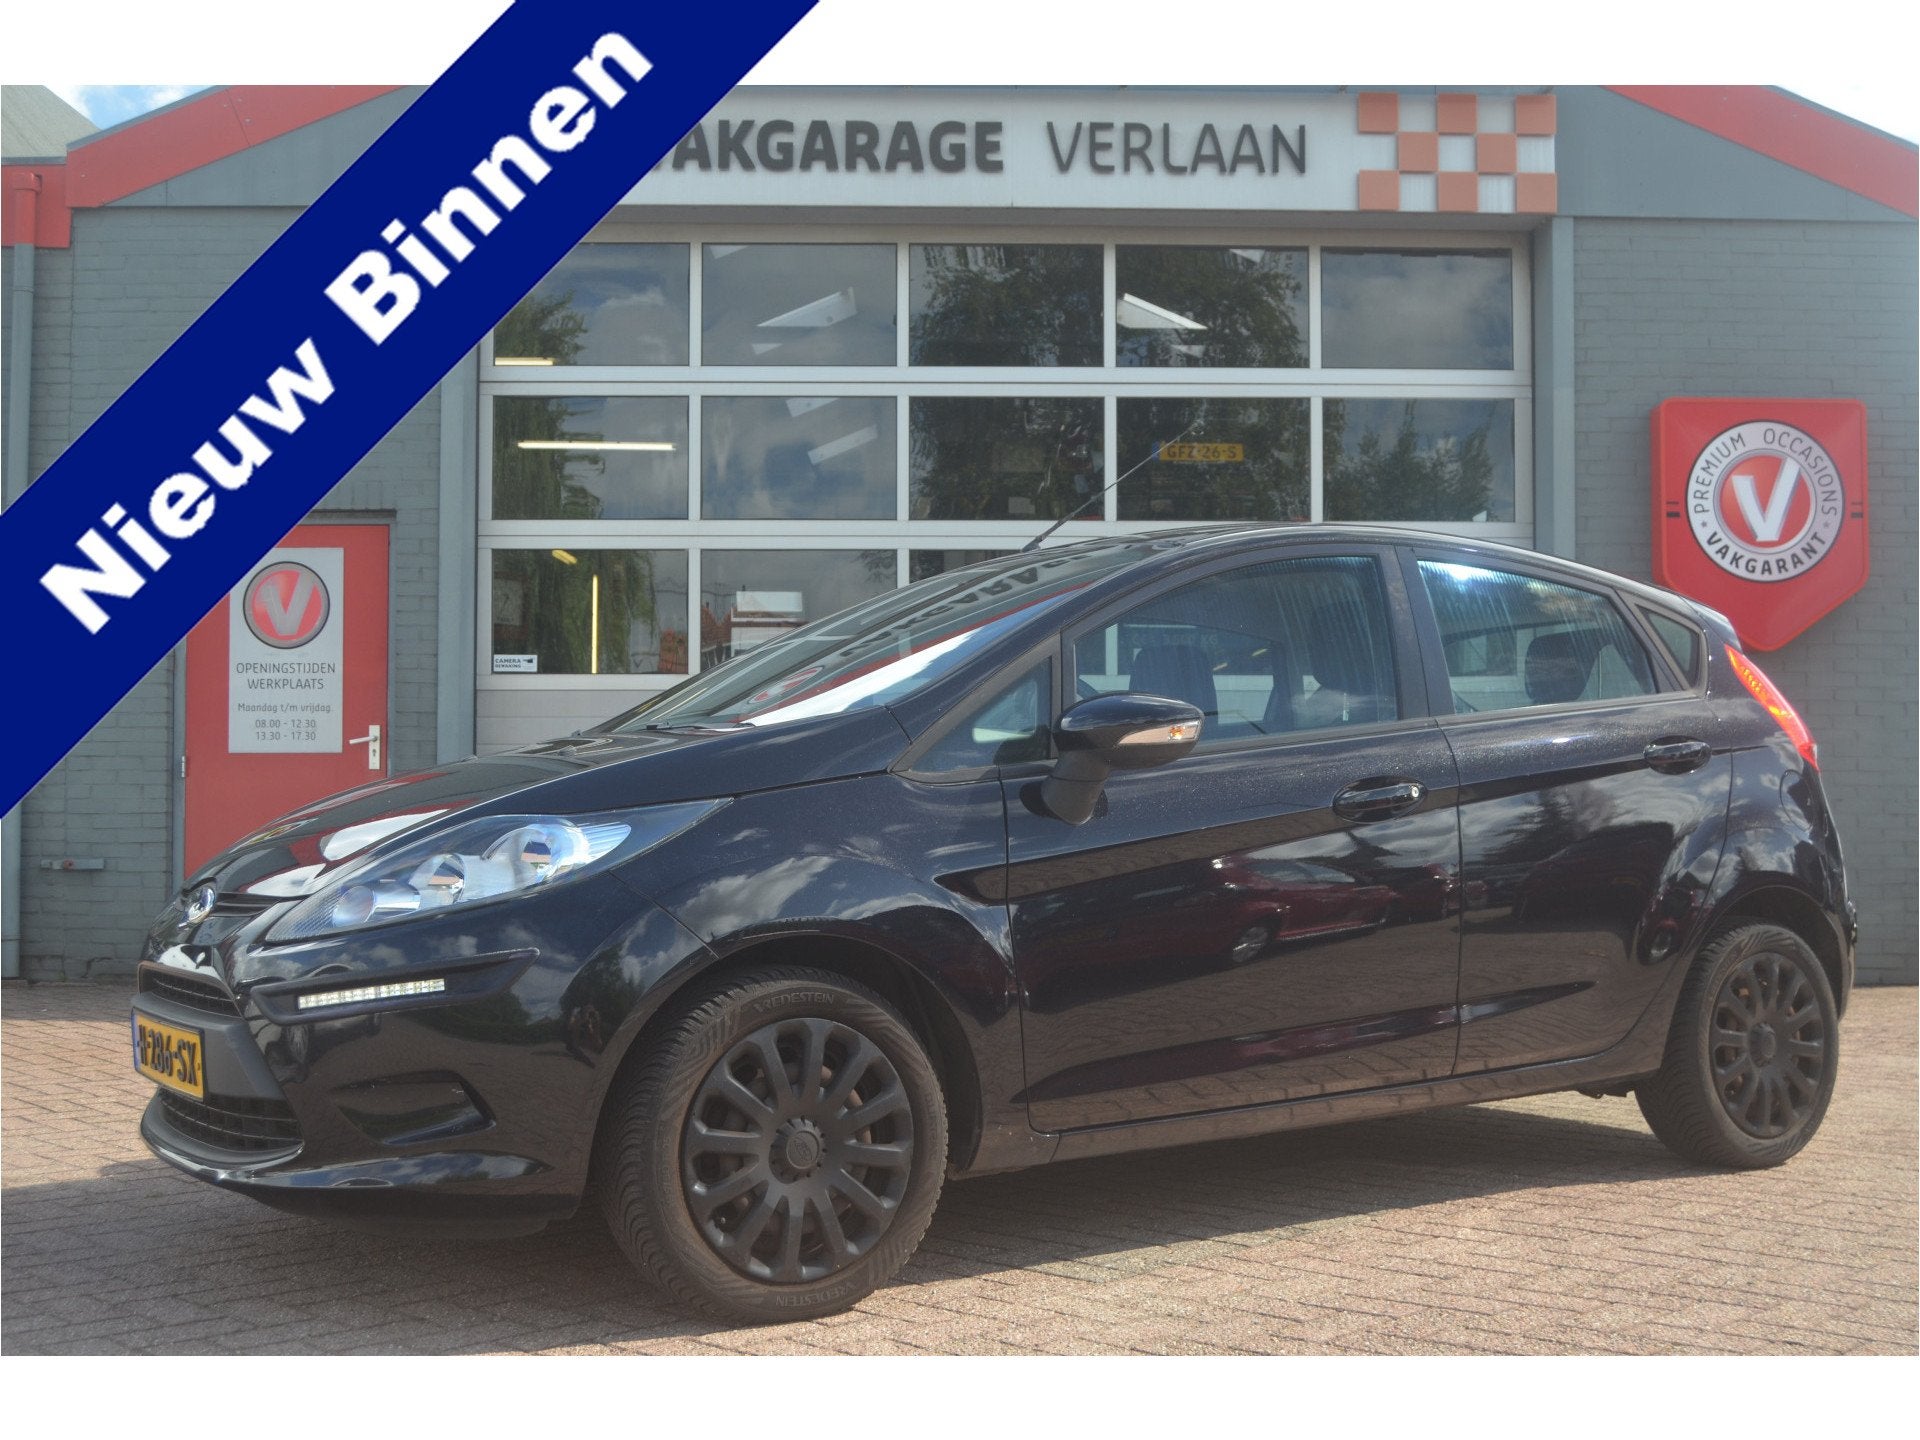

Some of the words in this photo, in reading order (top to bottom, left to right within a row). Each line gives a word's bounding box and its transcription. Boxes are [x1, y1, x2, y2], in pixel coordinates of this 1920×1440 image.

[653, 119, 1004, 173] AKGARAGE
[1046, 121, 1307, 174] VERLAAN
[1693, 432, 1746, 515] PREMIUM
[1762, 428, 1838, 517] OCCASIONS
[1706, 531, 1827, 576] VAKGARANT
[236, 662, 336, 674] OPENINGSTIJDEN
[247, 678, 324, 690] WERKPLAATS
[237, 703, 278, 714] Maandag
[280, 702, 298, 713] t/m
[300, 703, 331, 714] vrijdag
[255, 731, 281, 741] 13.30
[291, 731, 317, 741] 17.30
